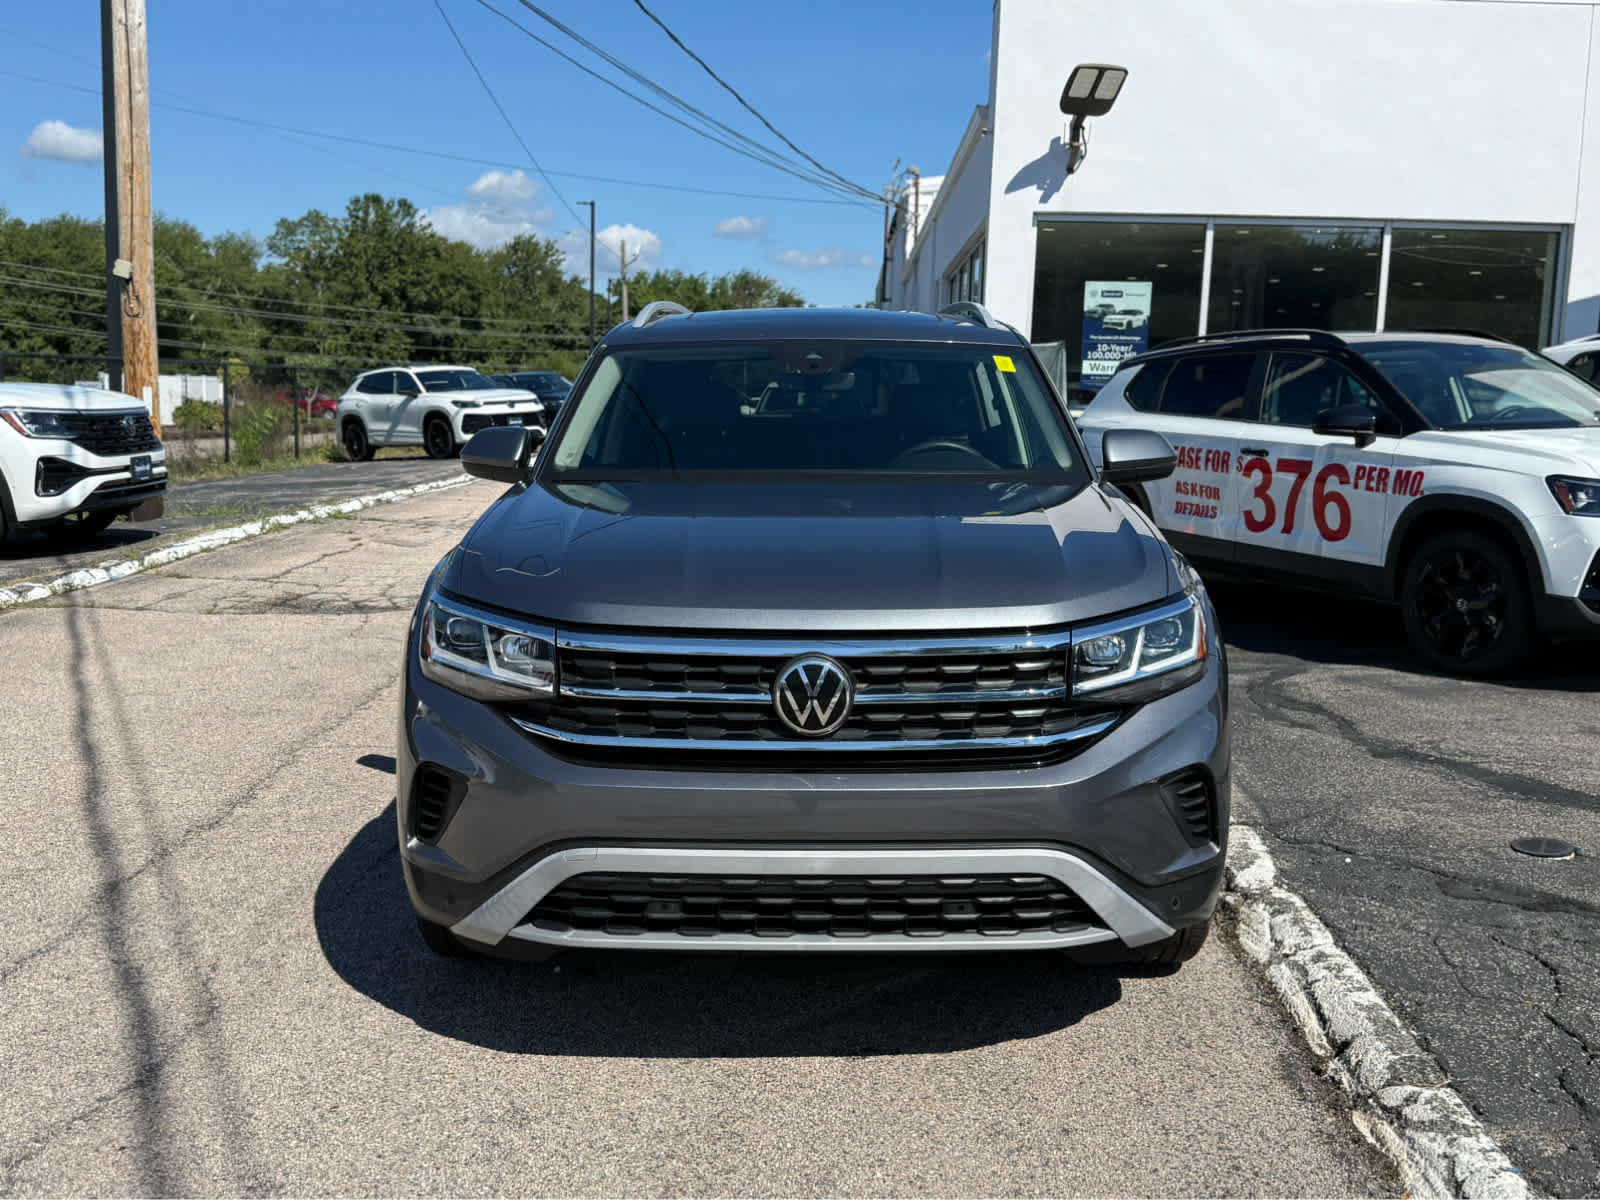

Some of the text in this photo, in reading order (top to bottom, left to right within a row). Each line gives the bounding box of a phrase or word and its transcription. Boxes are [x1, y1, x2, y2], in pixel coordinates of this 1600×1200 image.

[1097, 344, 1133, 352] 10-Year/
[1089, 363, 1114, 372] Warr
[1174, 445, 1203, 470] ASE
[1204, 450, 1231, 473] FOR
[1353, 464, 1388, 495] PER
[1391, 468, 1425, 497] MO.
[1175, 479, 1221, 501] ASK FOR
[1174, 500, 1218, 520] DETAILS
